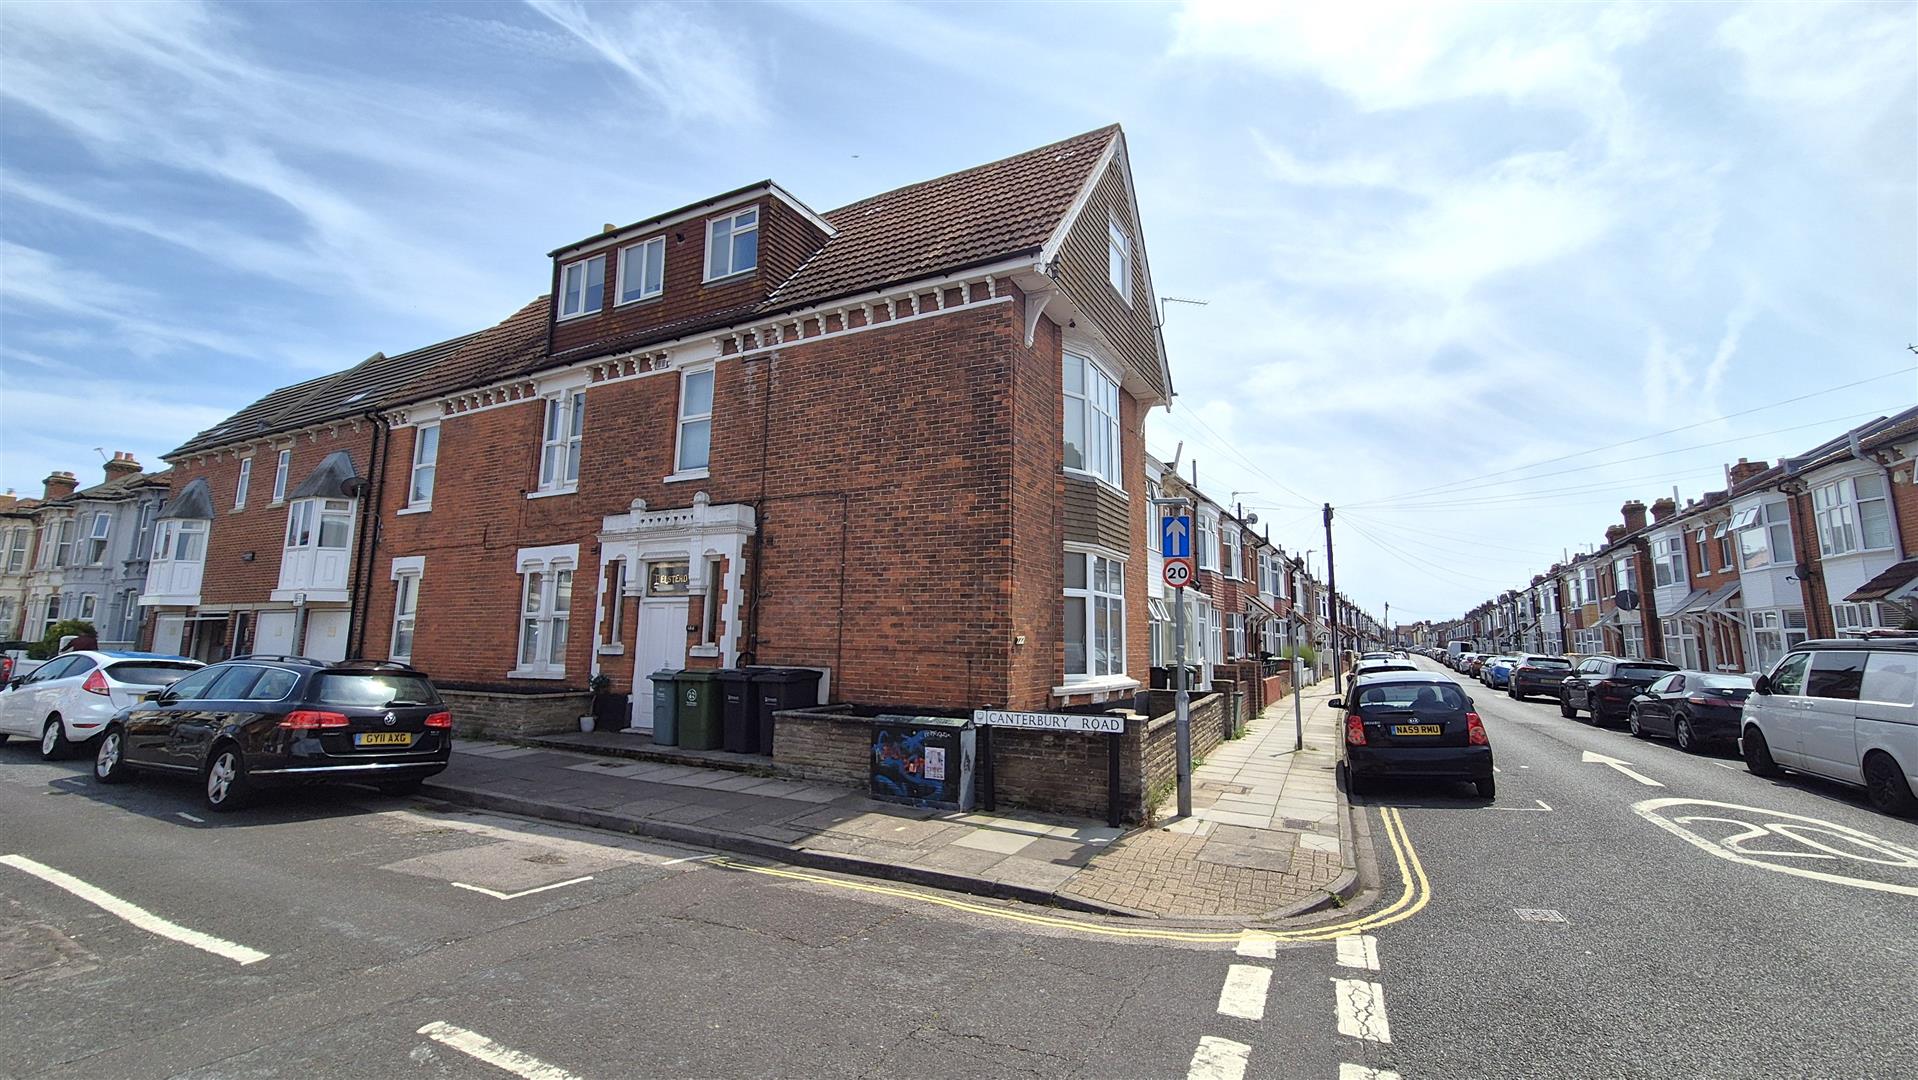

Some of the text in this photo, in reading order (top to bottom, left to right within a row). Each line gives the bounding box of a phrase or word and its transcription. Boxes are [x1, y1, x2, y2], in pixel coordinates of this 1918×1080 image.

[1167, 567, 1188, 579] 20
[989, 710, 1120, 731] CANTERBURY ROAD
[1396, 725, 1439, 734] NA59 RMU
[366, 733, 406, 743] GY11 AXG
[1674, 816, 1918, 868] 20
